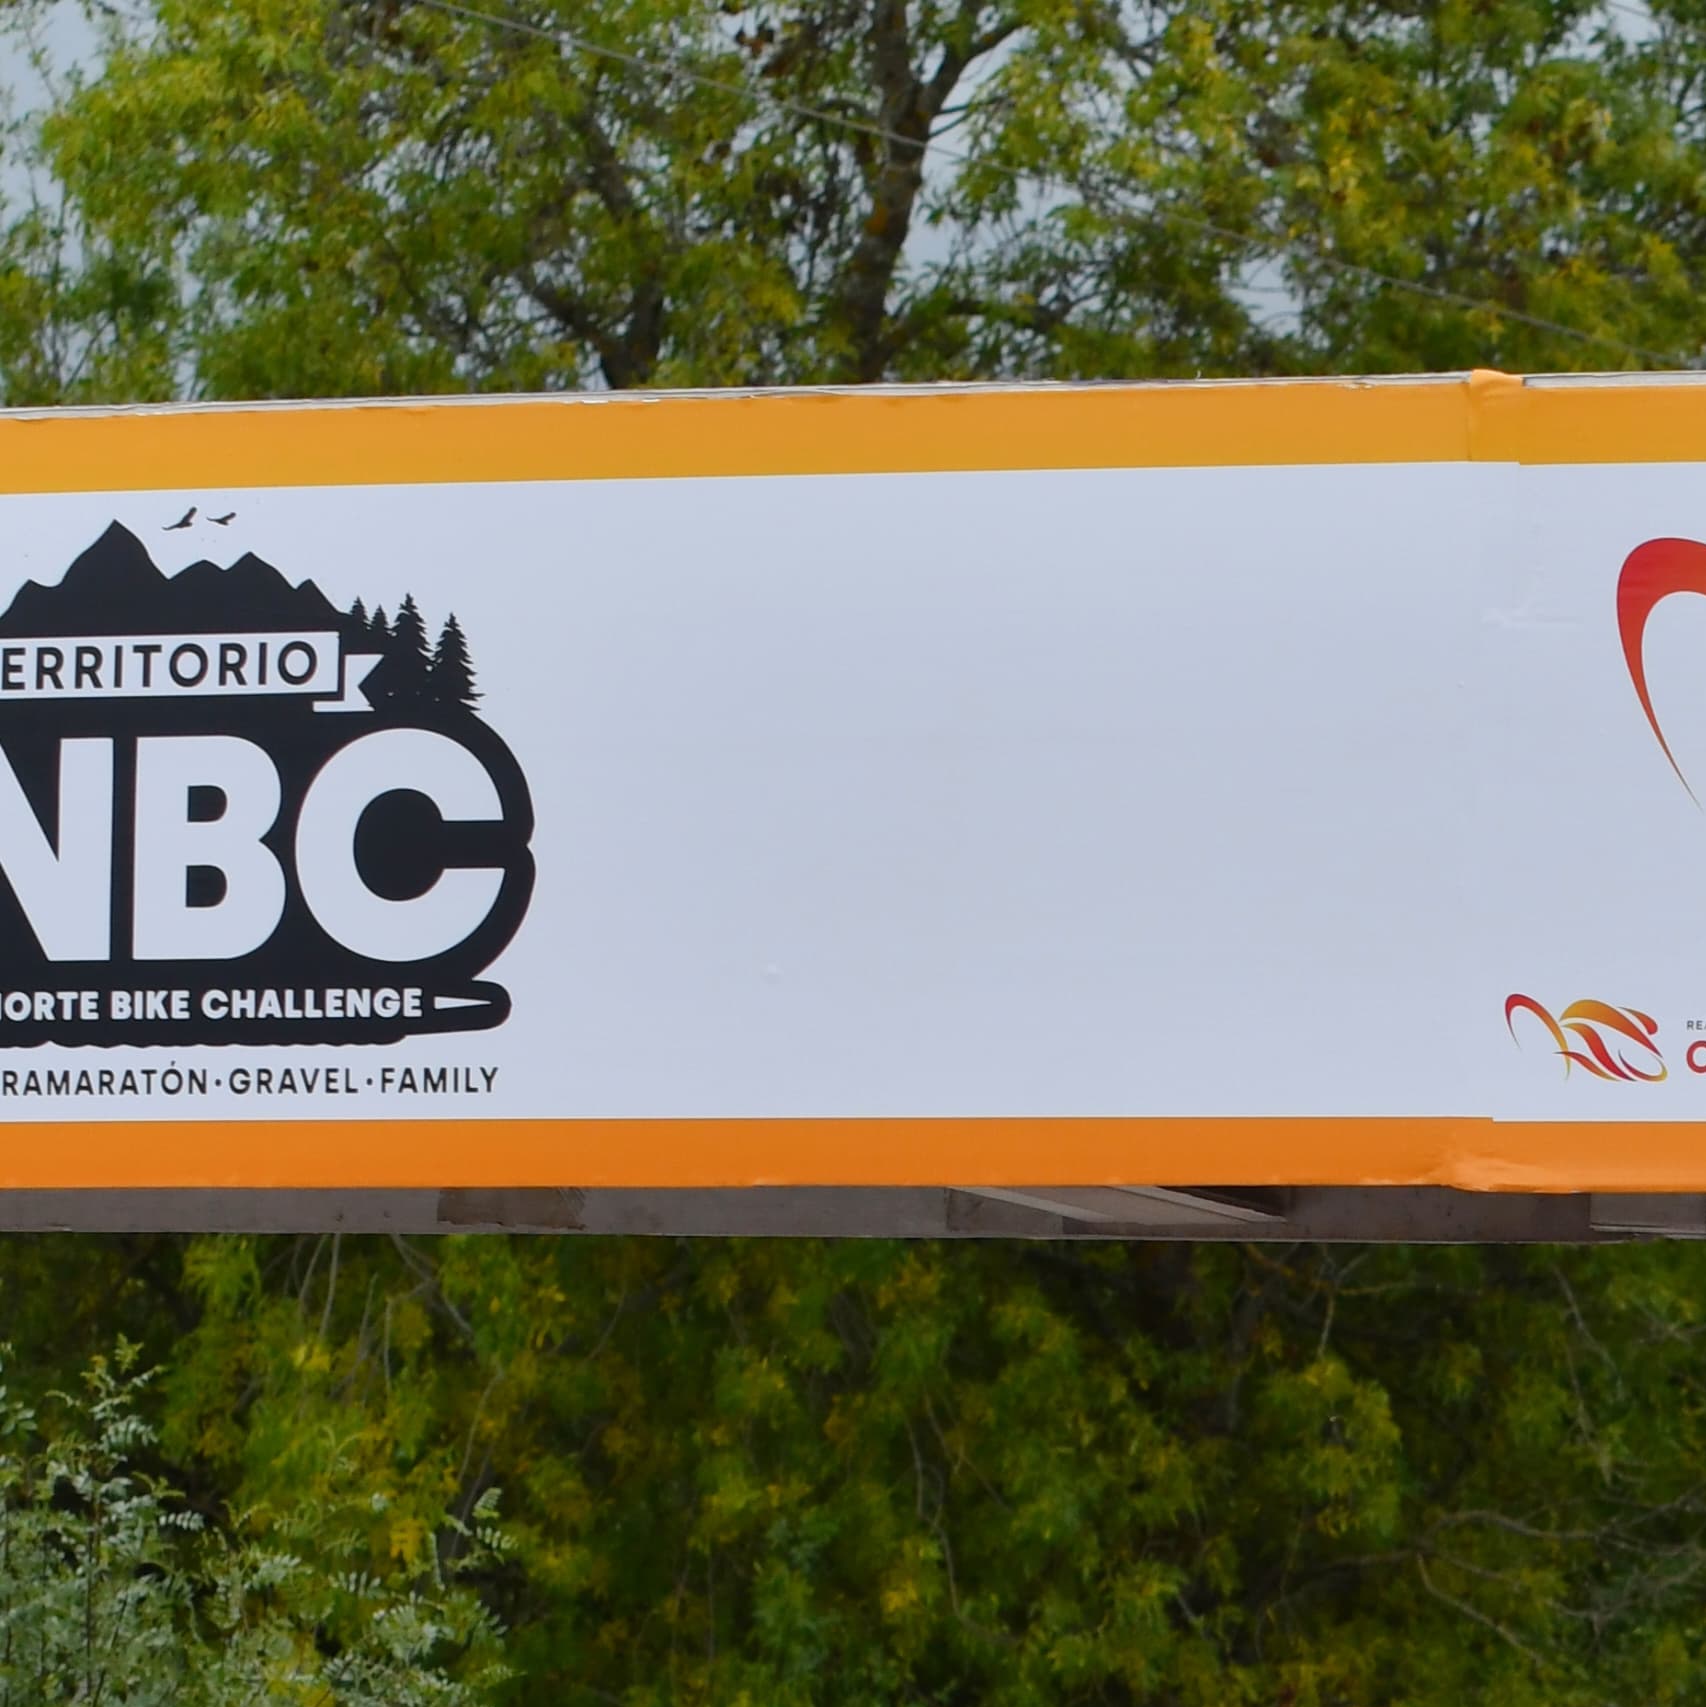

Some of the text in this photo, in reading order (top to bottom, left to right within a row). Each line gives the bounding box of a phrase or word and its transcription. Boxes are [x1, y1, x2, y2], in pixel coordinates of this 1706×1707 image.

[0, 988, 422, 1021] ORTE BIKE CHALLENGE
